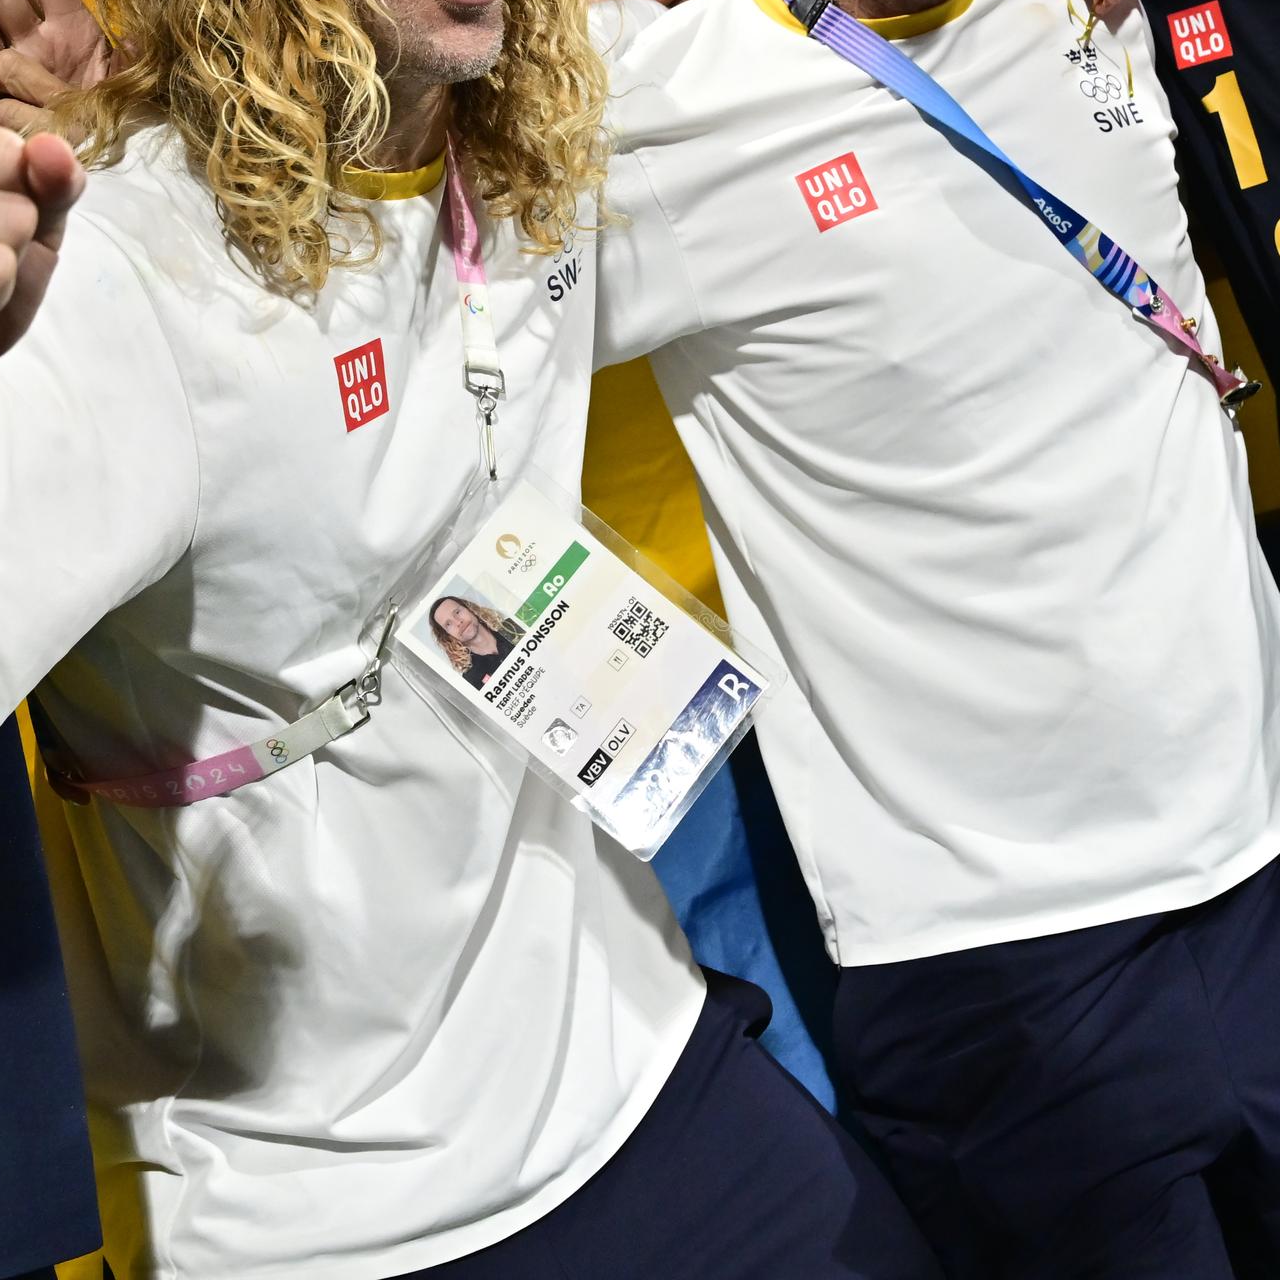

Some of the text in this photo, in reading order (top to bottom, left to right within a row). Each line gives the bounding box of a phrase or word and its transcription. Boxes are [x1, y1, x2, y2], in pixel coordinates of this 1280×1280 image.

[1173, 9, 1216, 39] UNI
[1180, 32, 1225, 63] QLO
[1093, 102, 1144, 133] SWE
[1201, 70, 1269, 190] 1
[804, 163, 854, 198] UNI
[817, 187, 867, 222] QLO
[341, 351, 377, 388] UNI
[347, 382, 383, 422] QLO
[484, 600, 570, 703] Rasmus JONSSON
[496, 665, 535, 711] TEAM LEADER
[504, 698, 522, 717] CHEF
[510, 693, 536, 723] Sweden
[516, 705, 537, 729] Suède
[582, 723, 630, 782] VBV OLV
